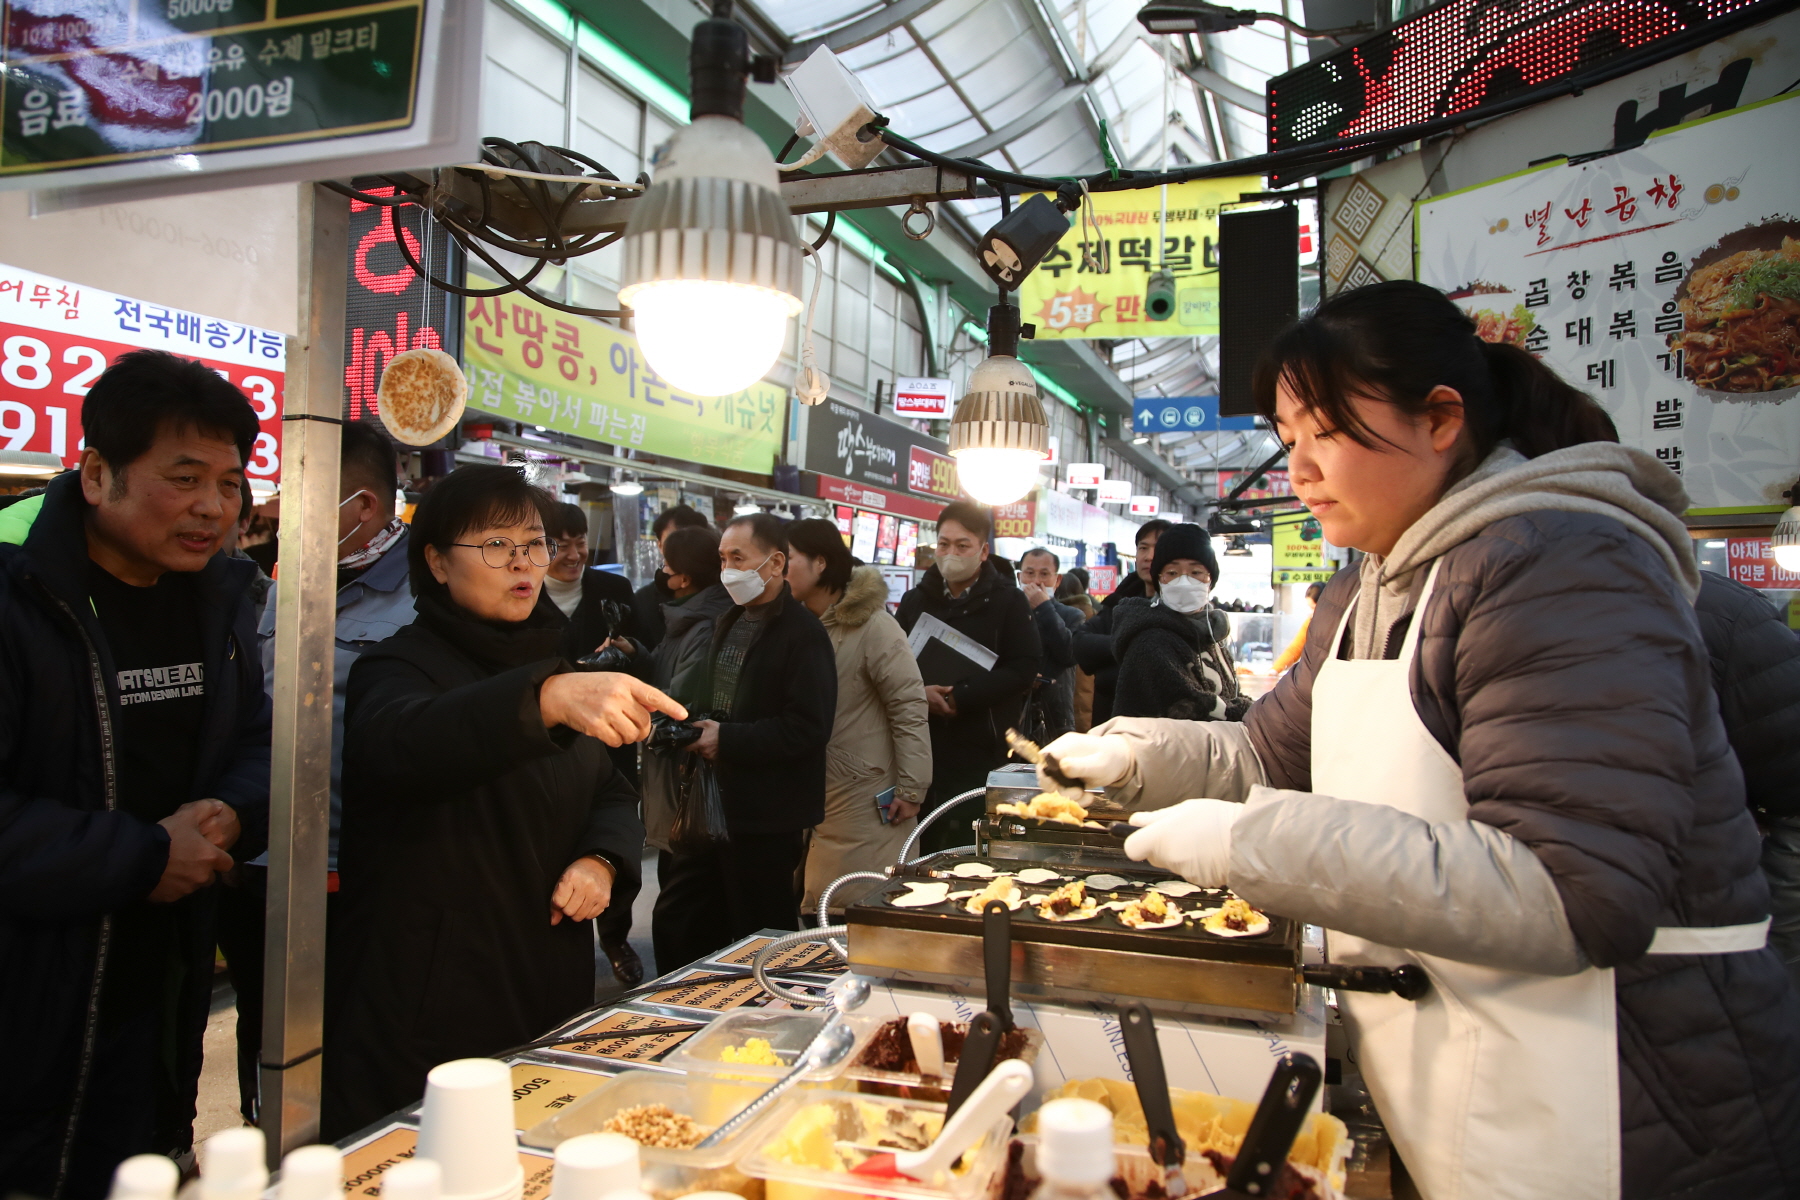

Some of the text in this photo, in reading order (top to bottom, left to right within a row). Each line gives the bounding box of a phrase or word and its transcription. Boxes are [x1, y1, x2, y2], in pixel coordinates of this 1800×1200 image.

[257, 34, 304, 66] 수제
[310, 22, 380, 61] 밀크티
[18, 76, 295, 138] 음료 2000원
[1086, 211, 1150, 227] 00%국내산
[1115, 294, 1168, 323] 만
[114, 298, 284, 359] 전국배송가능
[513, 380, 582, 430] 볶아서
[910, 459, 931, 490] 3인분
[931, 457, 965, 499] 9900
[993, 519, 1032, 538] 9900
[1731, 564, 1766, 581] 1인분
[150, 687, 180, 701] DENIM
[181, 684, 205, 697] LINE
[544, 1093, 577, 1109] 세트
